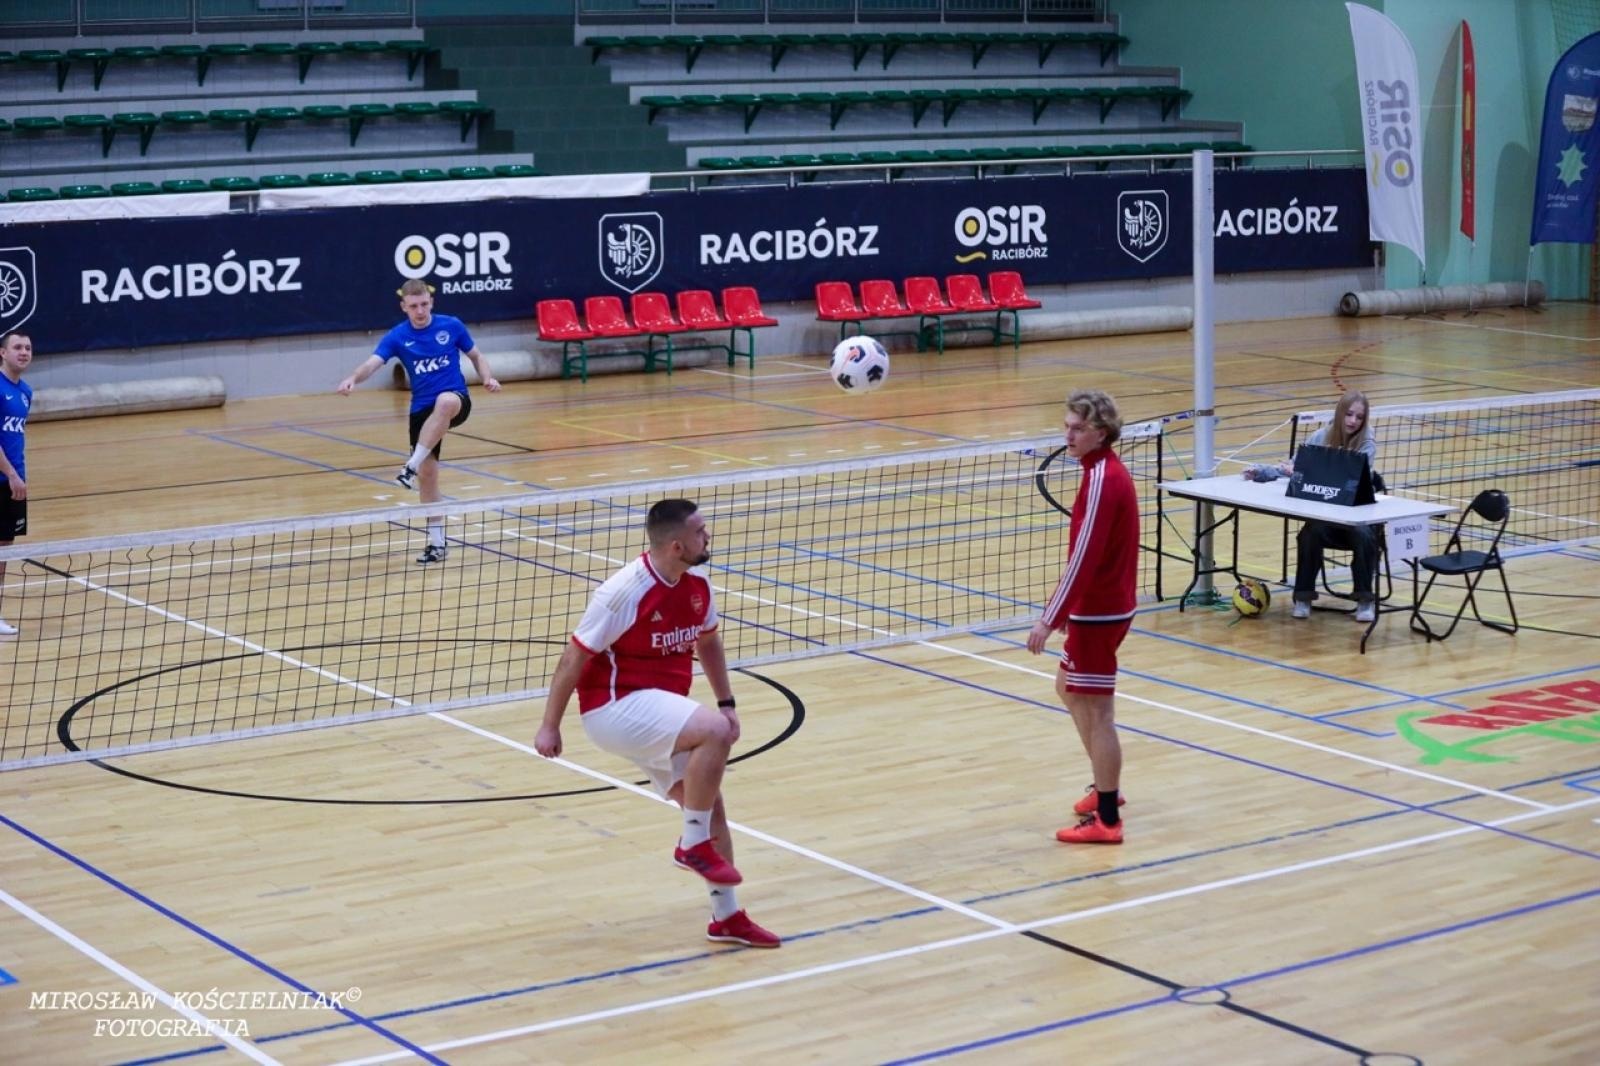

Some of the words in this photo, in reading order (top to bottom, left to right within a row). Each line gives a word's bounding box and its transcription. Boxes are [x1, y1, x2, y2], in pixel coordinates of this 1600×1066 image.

[1214, 197, 1338, 237] ACIBÓRZ
[700, 217, 880, 265] RACIBÓRZ
[992, 245, 1048, 260] RACIBÓRZ
[81, 249, 302, 304] RACIBÓRZ
[442, 276, 513, 294] RACIBÓRZ
[2, 416, 27, 433] KK
[1301, 483, 1341, 497] MODEST
[1394, 524, 1423, 536] BOISKO
[1405, 538, 1414, 550] B
[651, 624, 705, 649] Emirate
